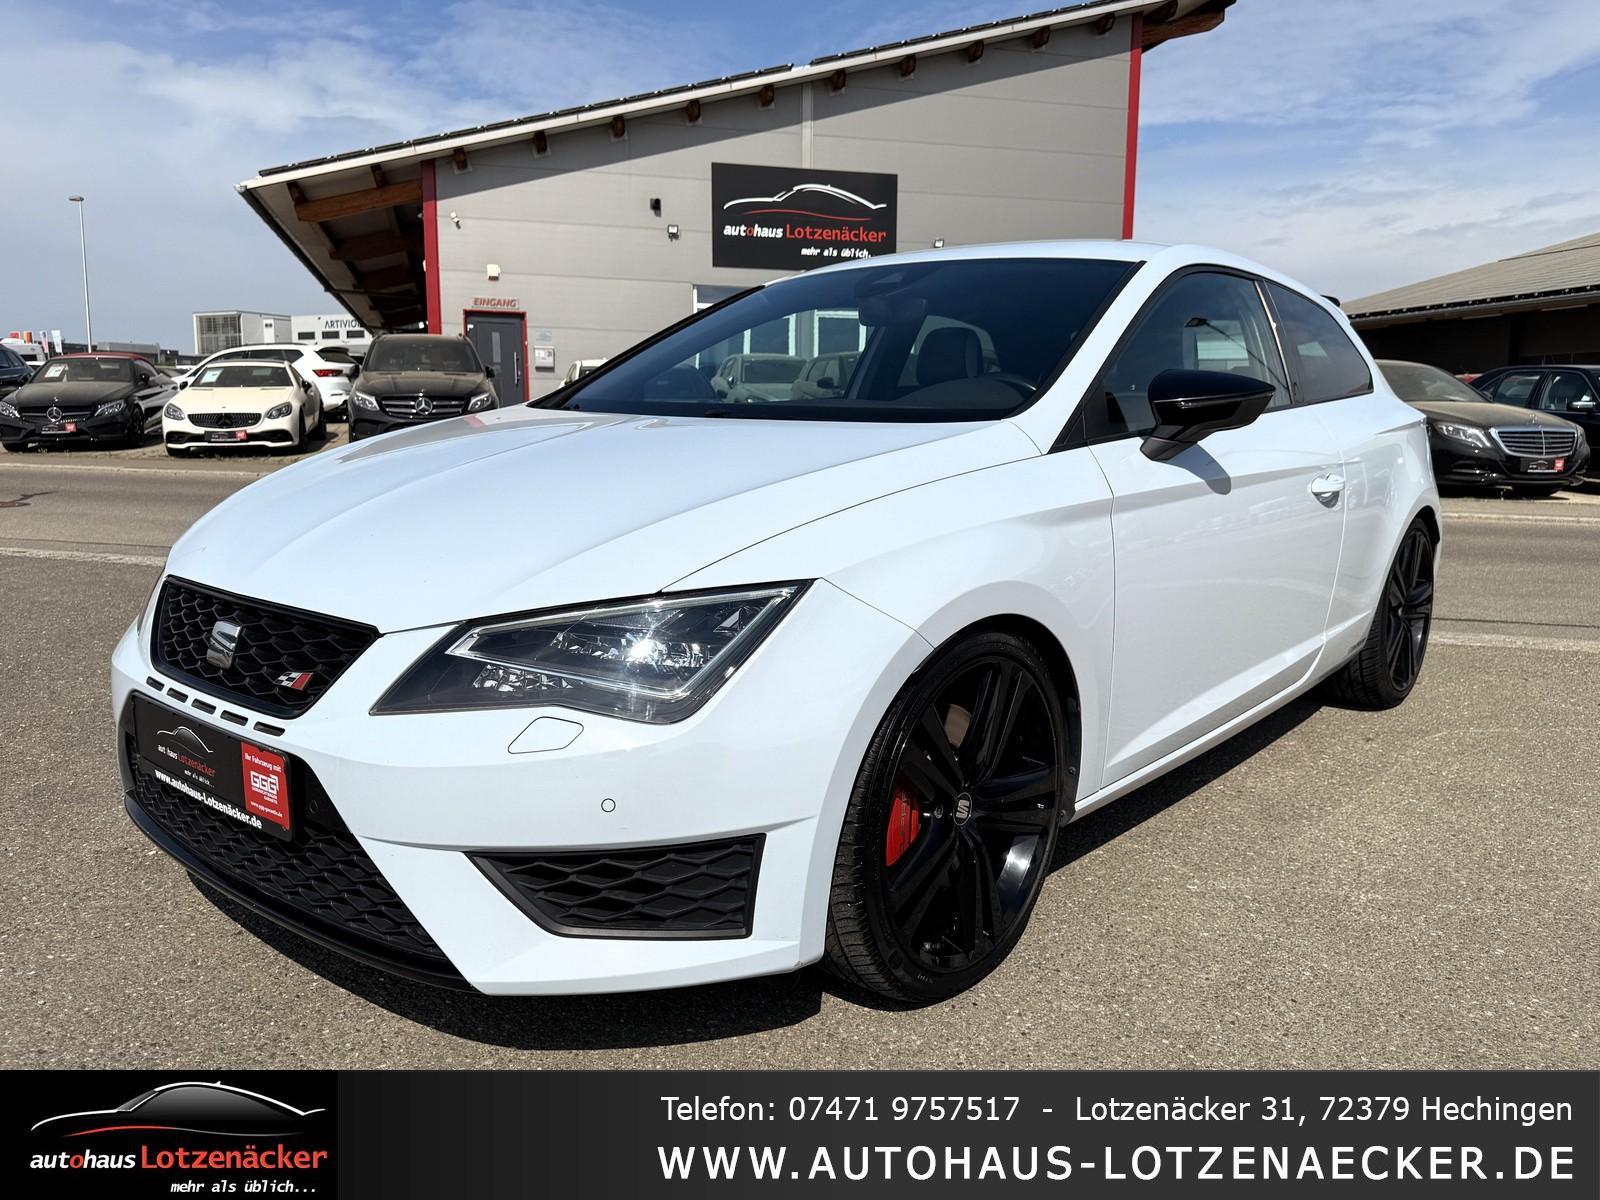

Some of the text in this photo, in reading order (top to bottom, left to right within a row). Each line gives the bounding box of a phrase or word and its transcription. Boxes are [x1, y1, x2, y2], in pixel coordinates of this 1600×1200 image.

[723, 223, 887, 243] autohaus Lotzenäcker
[801, 247, 820, 256] mehr
[823, 247, 838, 257] als
[473, 297, 517, 308] EINGANG
[324, 319, 361, 329] ARTIVIO
